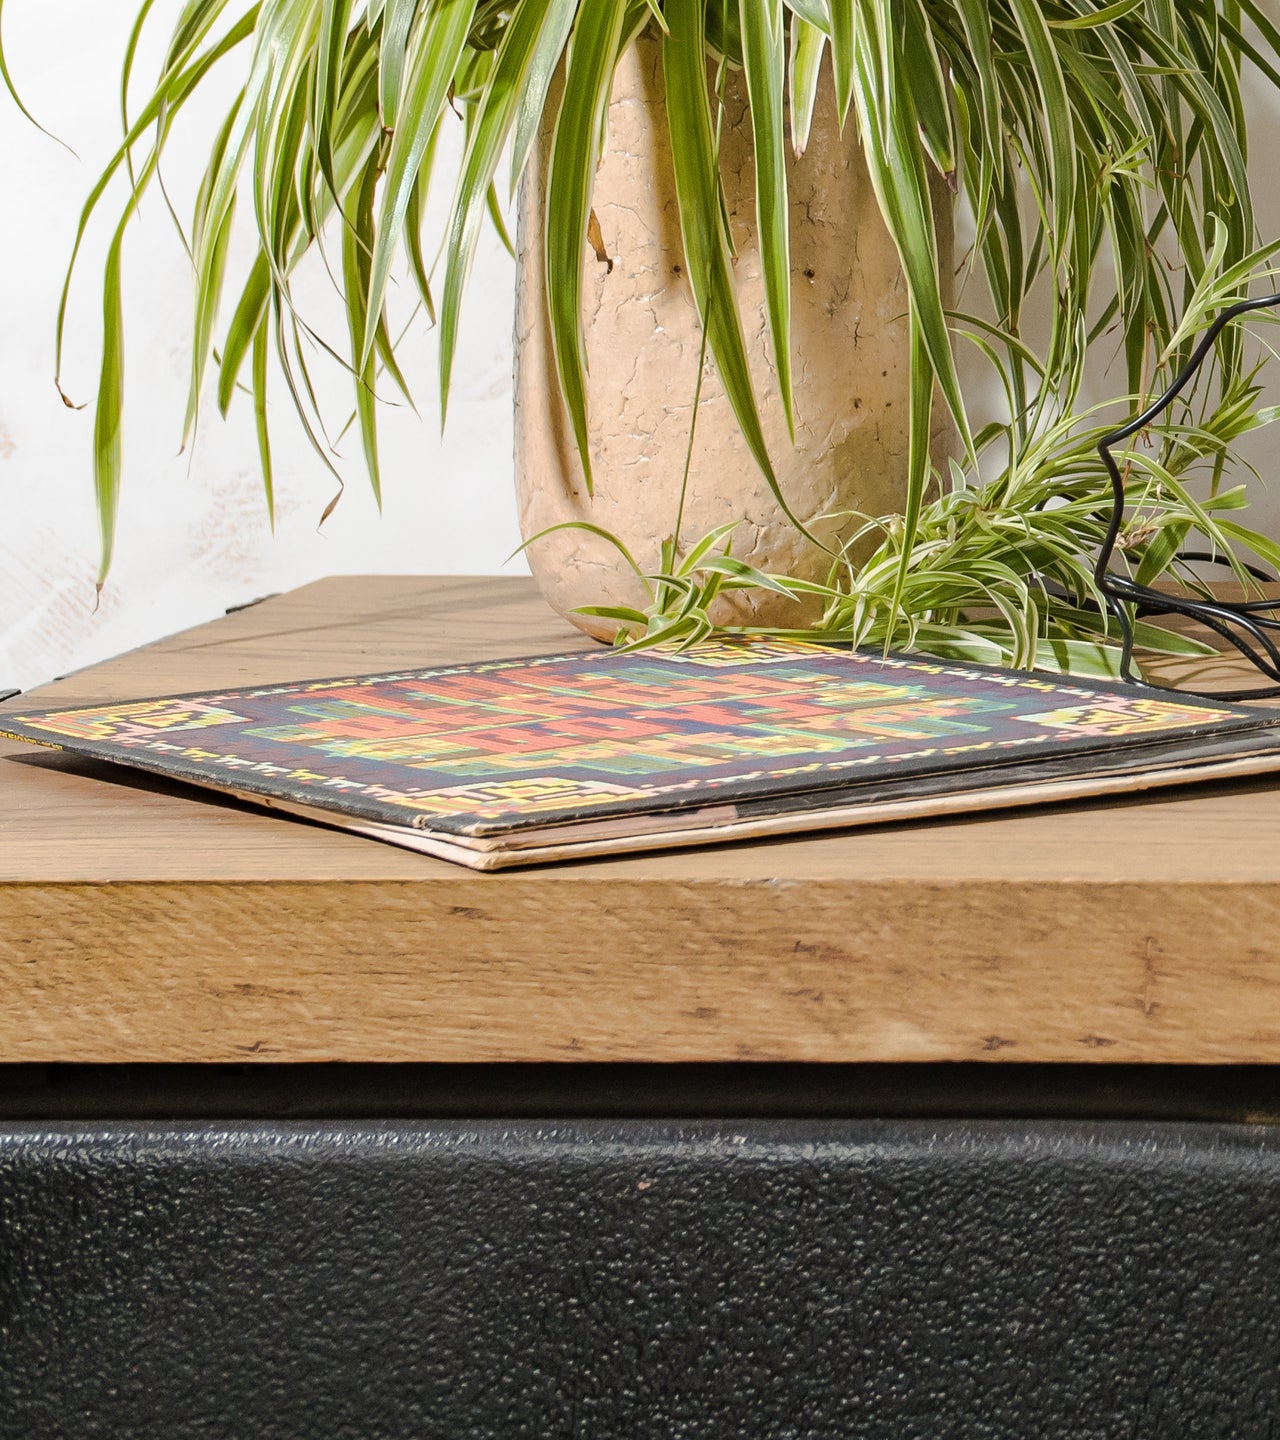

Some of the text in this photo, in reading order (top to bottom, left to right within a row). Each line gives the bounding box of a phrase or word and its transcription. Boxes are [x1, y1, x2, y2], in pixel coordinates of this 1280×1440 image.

[278, 665, 634, 713] THE
[293, 672, 821, 741] BEACH
[425, 691, 885, 755] BOYS
